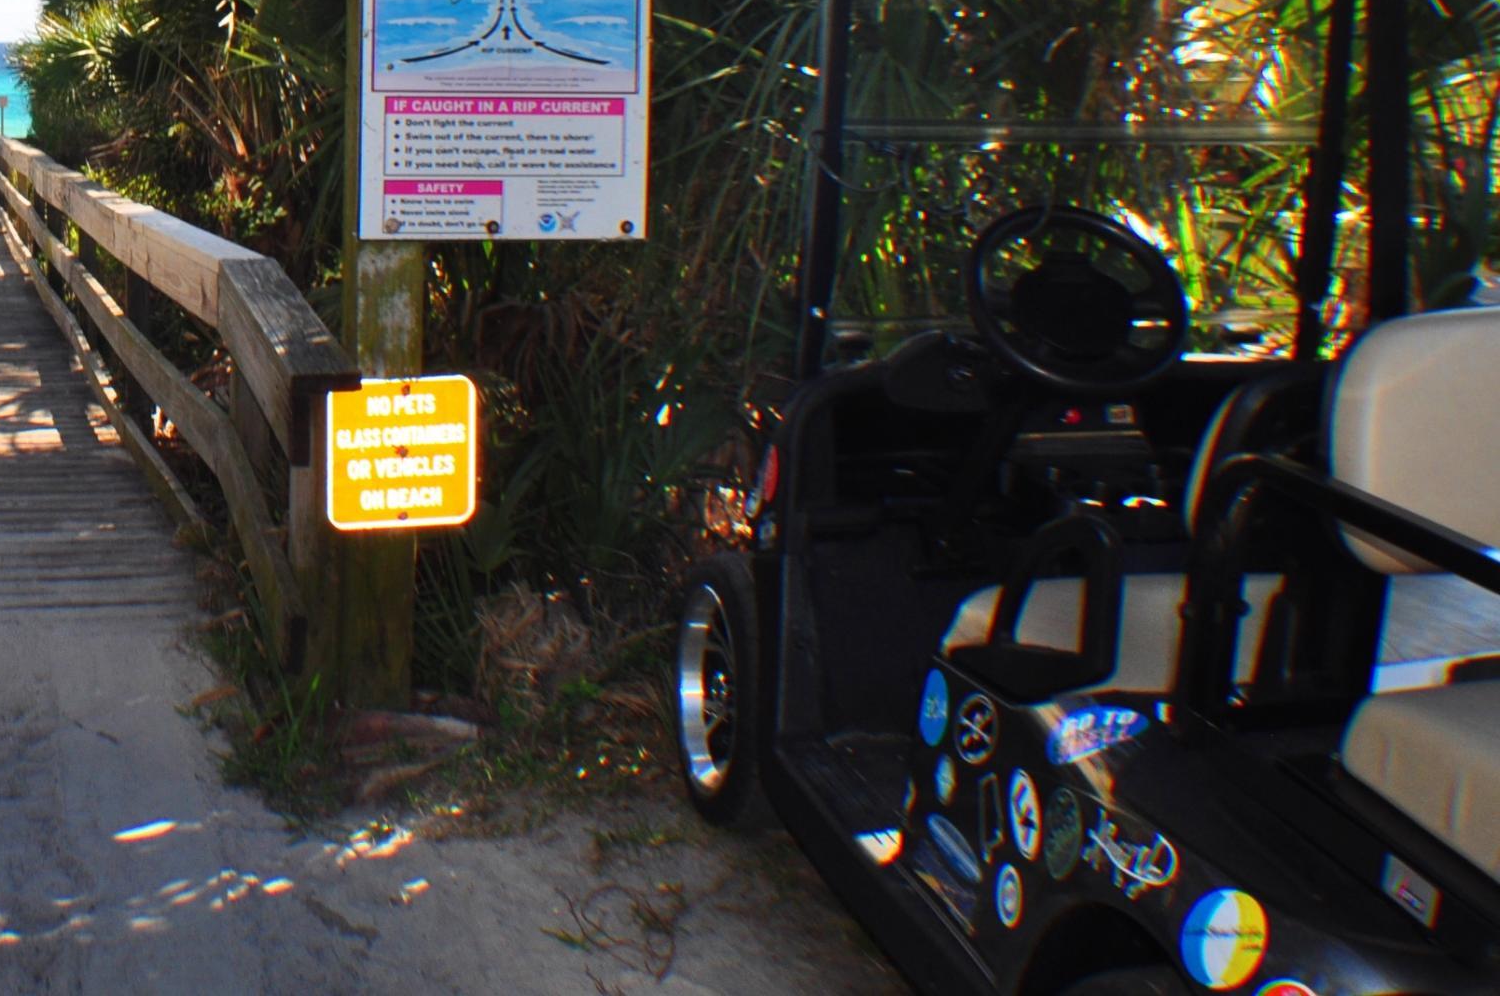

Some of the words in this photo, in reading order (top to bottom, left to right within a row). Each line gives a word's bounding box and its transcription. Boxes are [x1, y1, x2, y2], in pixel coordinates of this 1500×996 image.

[393, 100, 407, 112] IF
[411, 100, 474, 113] CAUGHT
[478, 100, 494, 113] IN
[498, 101, 509, 113] A
[513, 101, 537, 113] RIP
[541, 101, 611, 114] CURRENT
[433, 118, 456, 128] fight
[458, 118, 475, 127] the
[477, 119, 514, 127] current
[405, 132, 432, 140] Swim
[435, 132, 451, 140] out
[453, 132, 464, 140] of
[466, 132, 483, 140] the
[415, 147, 433, 155] you
[568, 147, 596, 155] water
[415, 161, 433, 170] you
[436, 160, 460, 168] need
[417, 182, 465, 195] SAFETY
[366, 395, 391, 417] NO
[393, 393, 437, 416] PETS
[336, 428, 382, 450] GLASS
[382, 423, 466, 447] CONTAINERS
[347, 459, 372, 481] OR
[374, 454, 456, 479] VEHICLES
[359, 489, 385, 511] ON
[386, 486, 444, 510] BEACH
